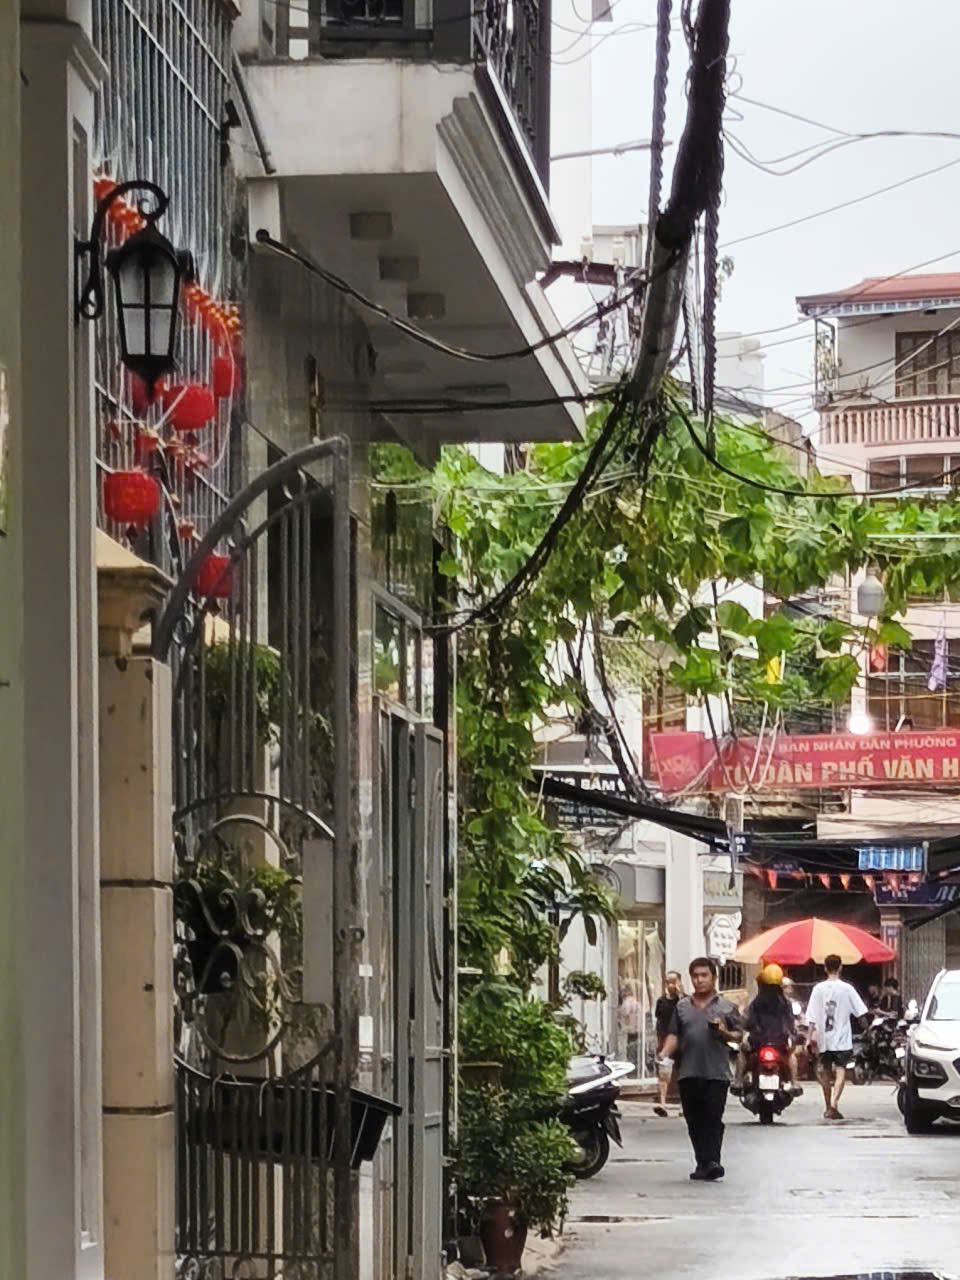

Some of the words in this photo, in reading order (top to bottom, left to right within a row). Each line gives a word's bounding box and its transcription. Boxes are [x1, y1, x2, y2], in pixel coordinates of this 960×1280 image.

[780, 741, 809, 753] BAN
[813, 739, 856, 752] NHÂN
[860, 738, 890, 750] DÂN
[894, 735, 957, 750] PHƯỜNG
[821, 753, 875, 783] PHỐ
[882, 754, 934, 779] VĂN
